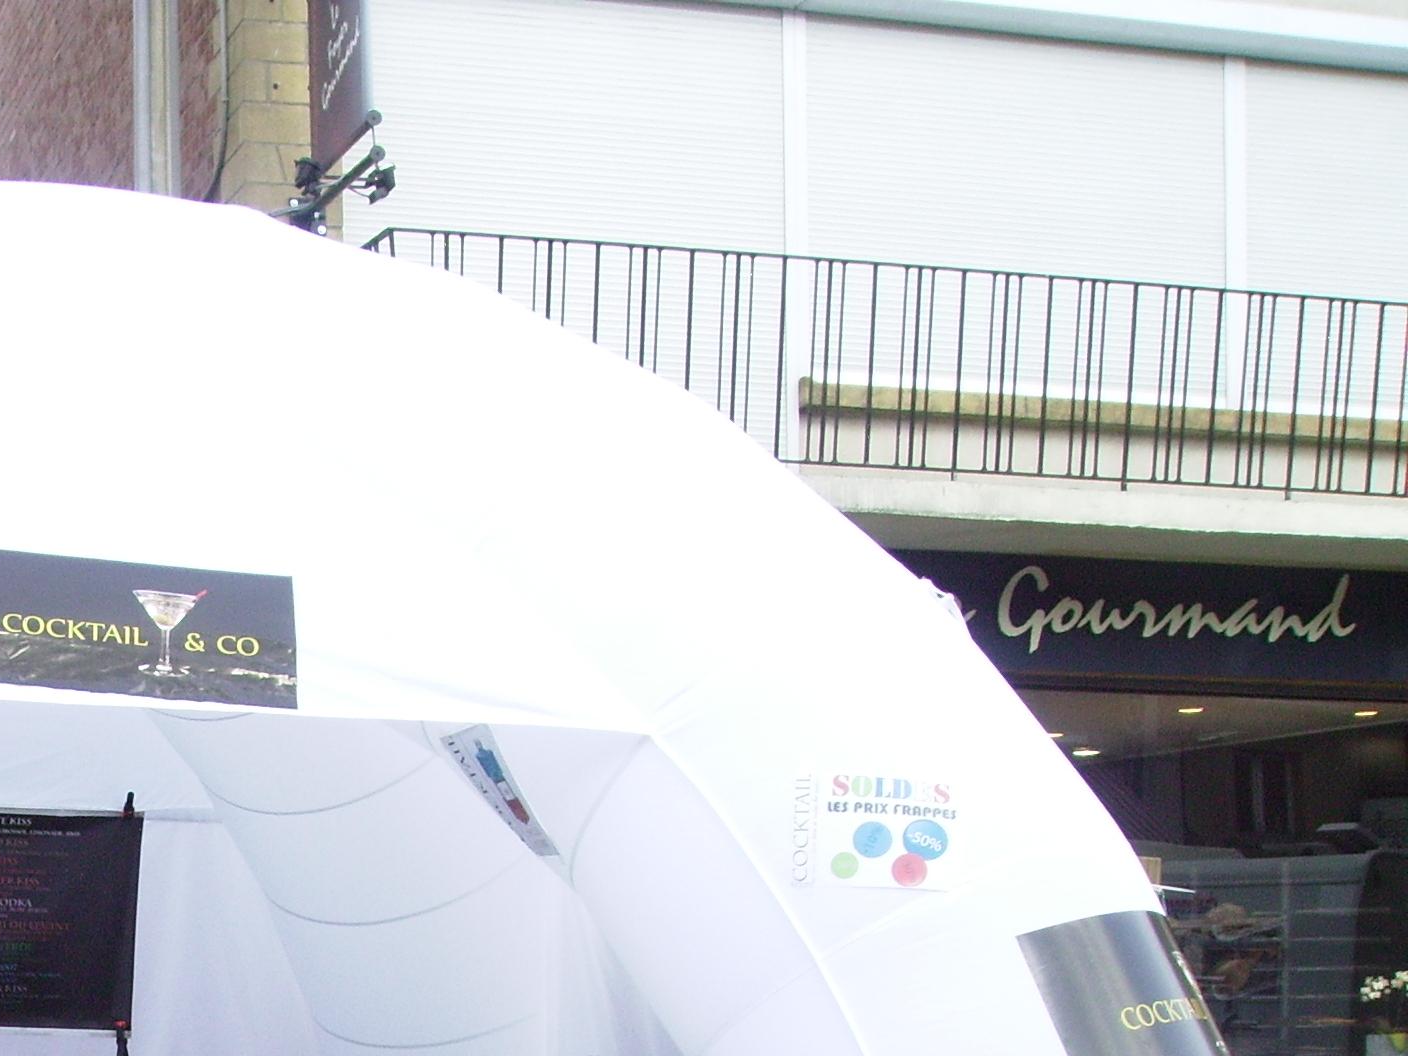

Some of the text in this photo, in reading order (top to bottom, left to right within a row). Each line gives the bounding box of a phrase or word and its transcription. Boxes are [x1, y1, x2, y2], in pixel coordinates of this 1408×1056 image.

[997, 565, 1356, 654] Gourmand
[2, 612, 261, 657] COCKTAIL & CO
[9, 817, 32, 825] KISS
[827, 801, 849, 813] LES
[854, 802, 888, 814] PRIX
[792, 773, 812, 882] COCKTAIL
[1120, 998, 1208, 1030] COCKTA
